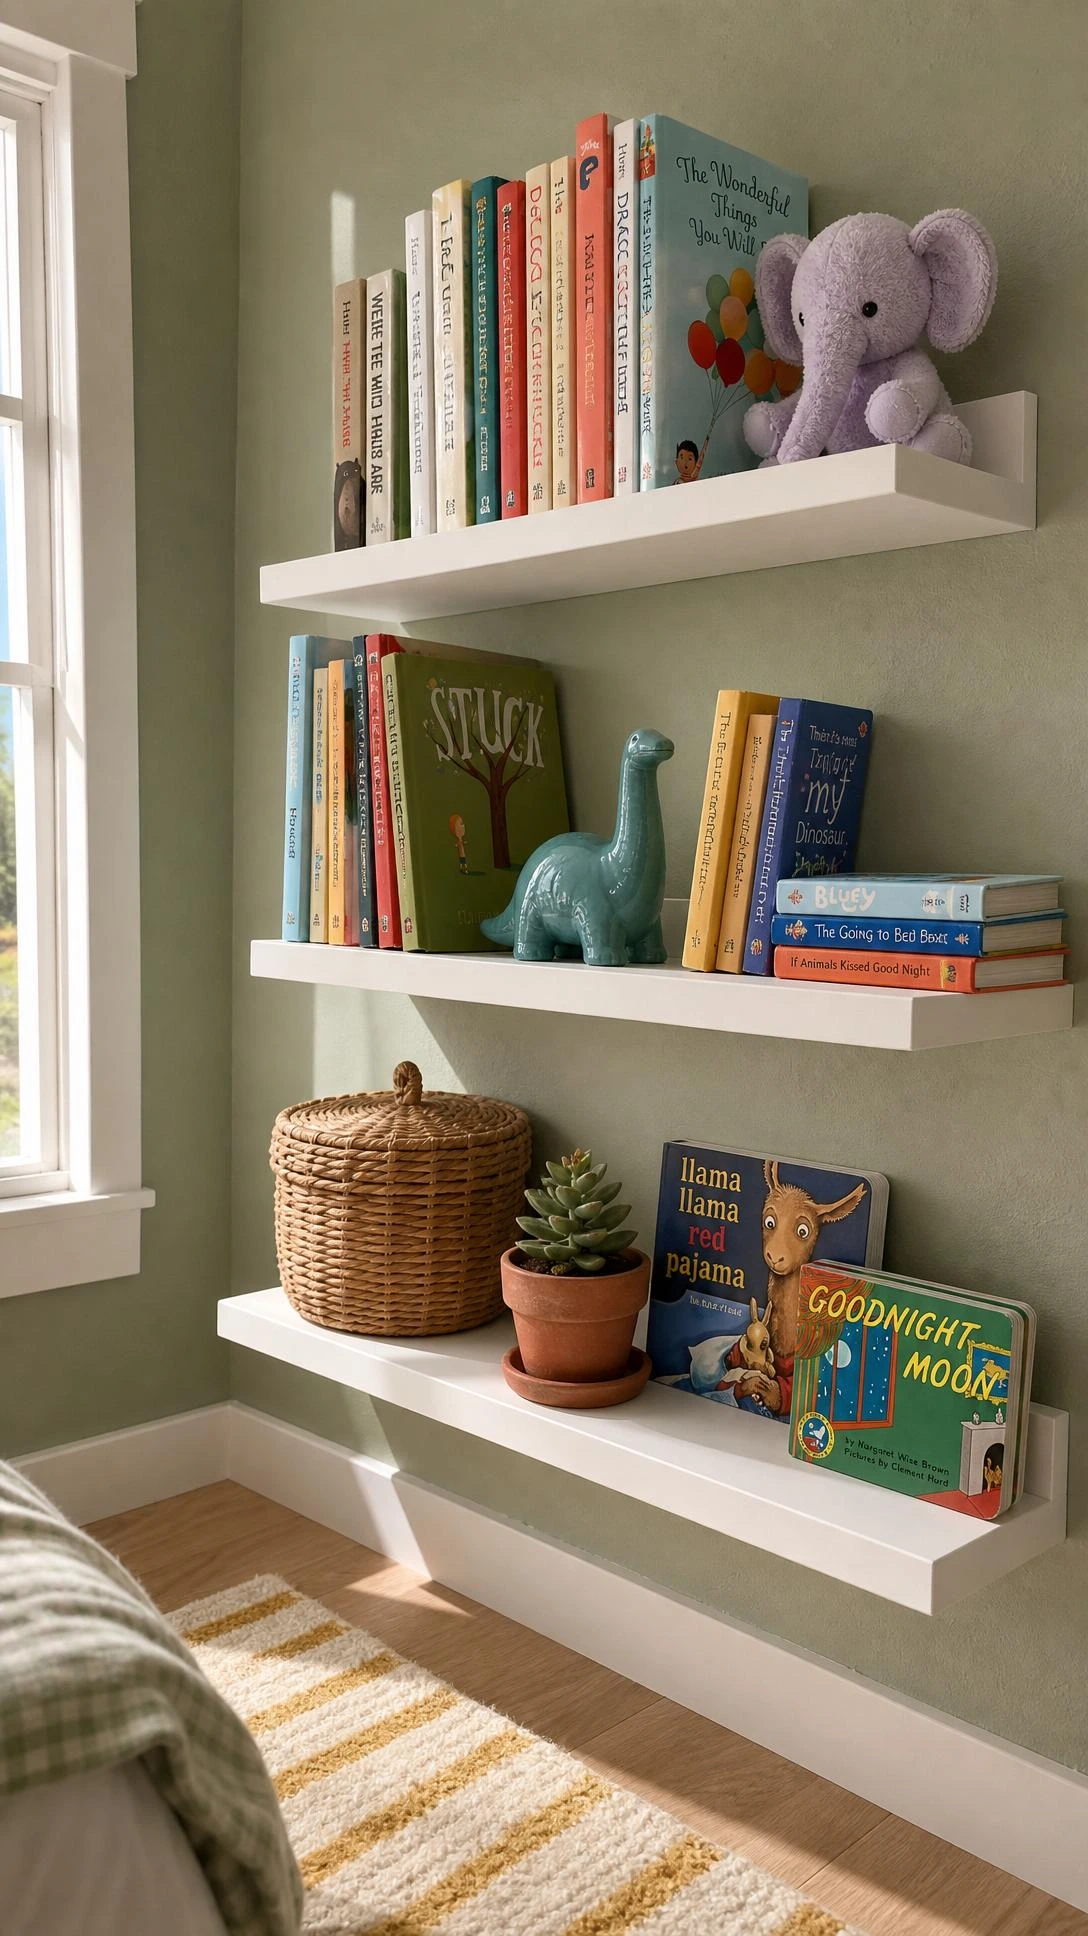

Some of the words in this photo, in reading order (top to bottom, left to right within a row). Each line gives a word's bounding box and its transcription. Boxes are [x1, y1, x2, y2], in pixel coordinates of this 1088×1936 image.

[676, 156, 709, 184] The
[710, 160, 791, 218] Wonderful
[711, 192, 758, 233] Things
[689, 217, 721, 247] You
[723, 226, 756, 257] Will
[428, 686, 545, 769] STUCK
[804, 767, 852, 826] my
[814, 924, 836, 939] The
[877, 930, 890, 941] to
[790, 956, 799, 968] If
[800, 957, 838, 970] Animals
[840, 959, 870, 973] Kissed
[873, 961, 900, 975] Good
[902, 963, 931, 978] Night
[680, 1156, 742, 1192] llama
[678, 1187, 740, 1223] llama
[687, 1223, 726, 1252] red
[665, 1251, 746, 1289] pajama
[808, 1285, 982, 1350] GOODNIGHT
[903, 1351, 1000, 1401] MOON
[844, 1447, 876, 1464] Pictures
[878, 1458, 889, 1469] by
[891, 1462, 924, 1480] Clement
[927, 1473, 949, 1488] Hurd
[921, 1459, 950, 1475] Brown
